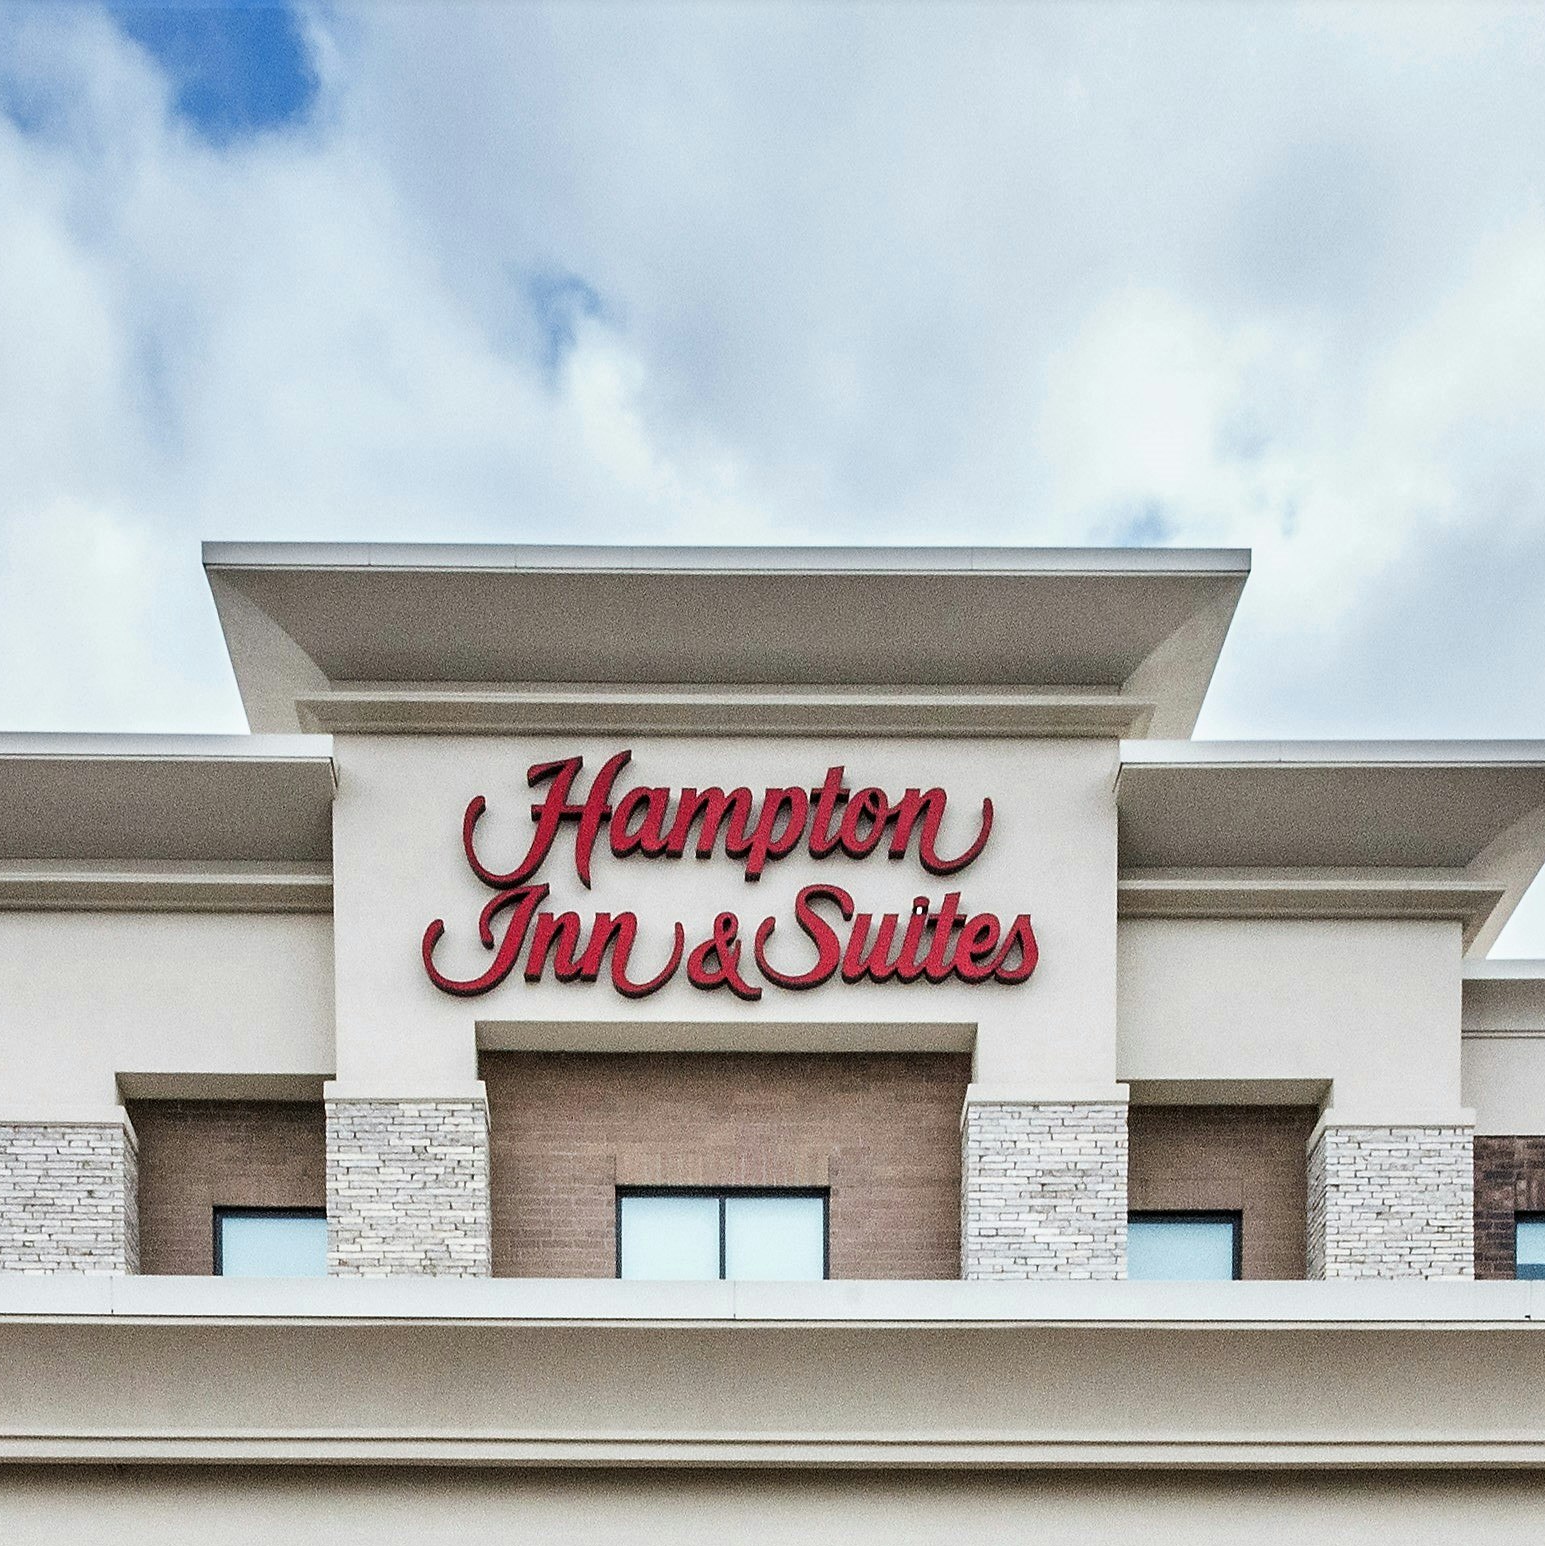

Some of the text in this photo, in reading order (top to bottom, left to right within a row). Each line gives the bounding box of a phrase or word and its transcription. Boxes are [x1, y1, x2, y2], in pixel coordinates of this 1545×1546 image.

[463, 749, 993, 889] Hampton
[422, 883, 1039, 1000] Inn & Suites
